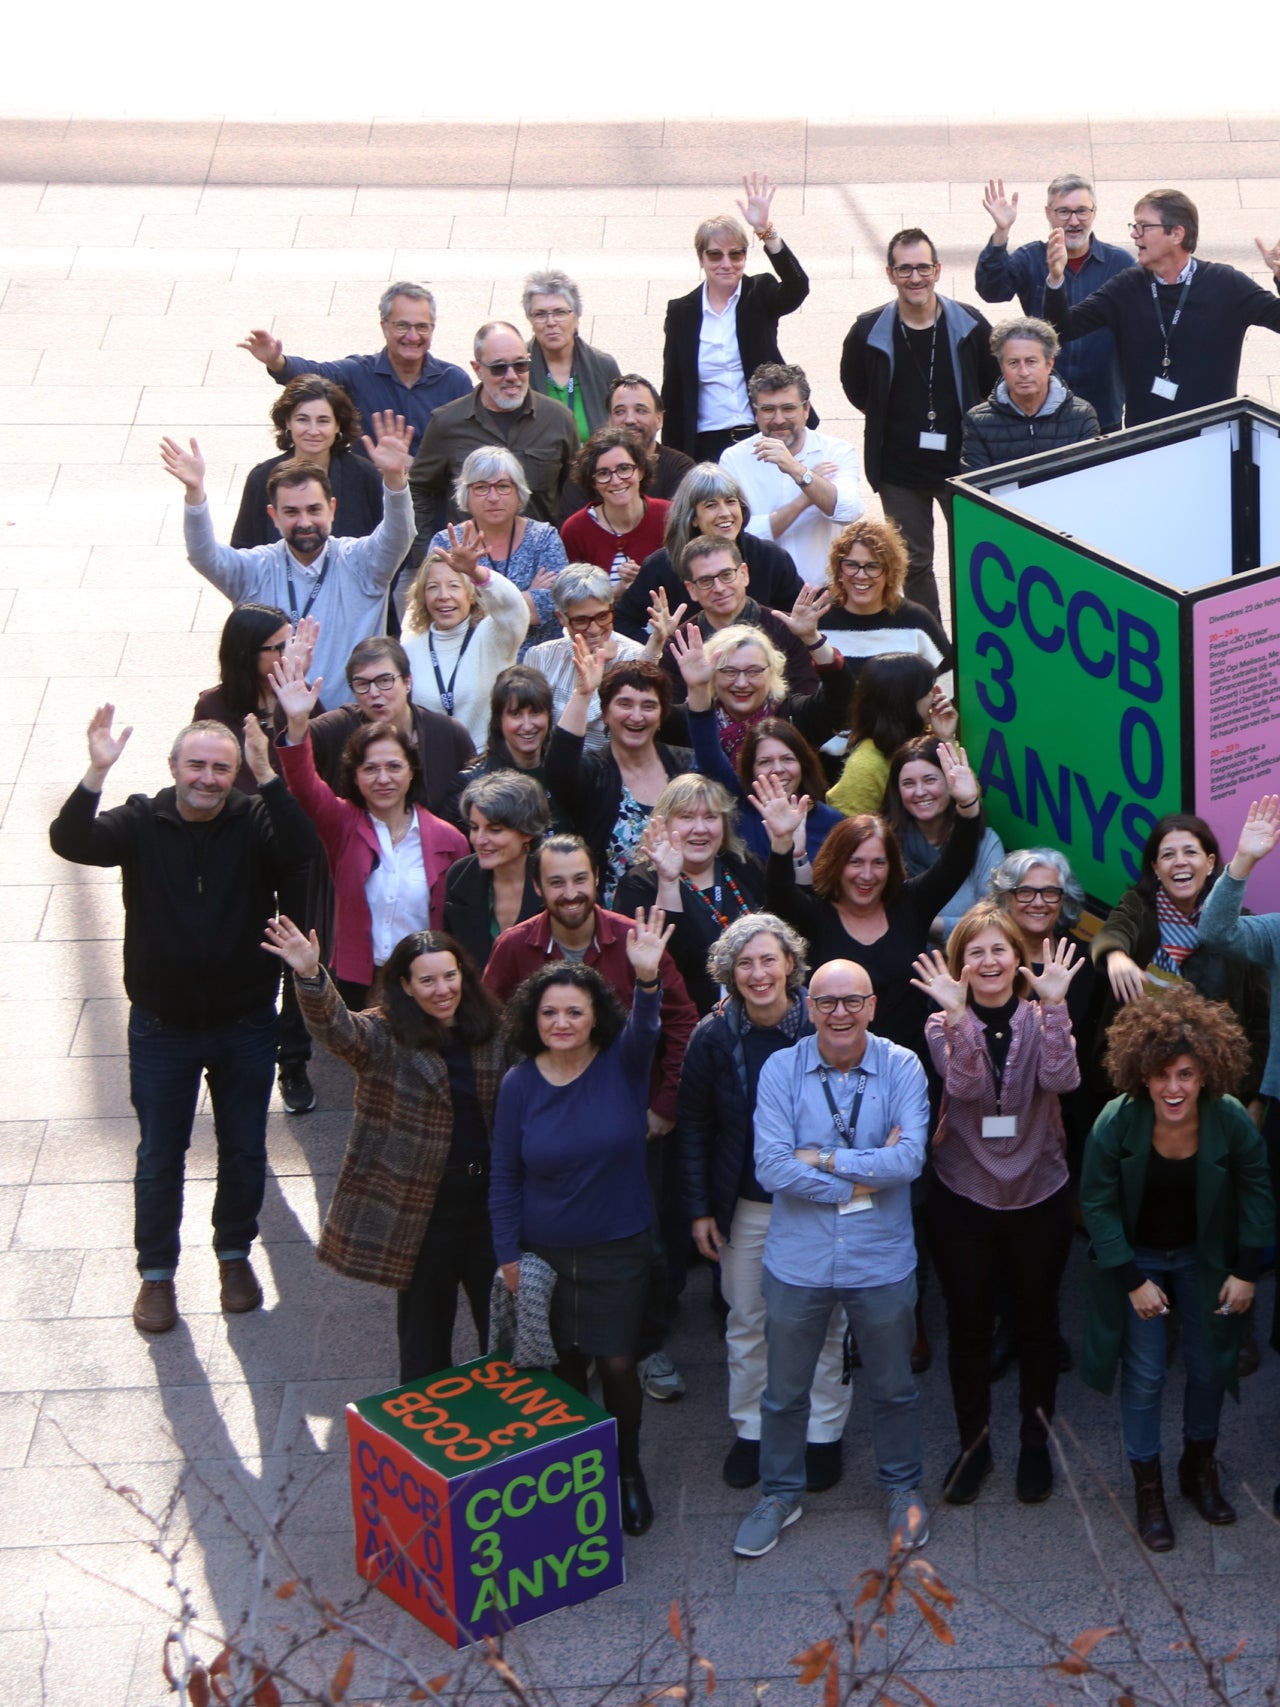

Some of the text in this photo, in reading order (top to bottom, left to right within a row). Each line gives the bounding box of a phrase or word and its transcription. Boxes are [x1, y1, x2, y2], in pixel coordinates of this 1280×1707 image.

[970, 541, 1163, 703] CCCB
[975, 631, 1164, 799] 3 0
[978, 728, 1159, 882] ANYS
[833, 1113, 845, 1133] CCCB
[857, 1074, 866, 1094] CCCB
[382, 1392, 491, 1461] CCCB
[470, 1361, 585, 1428] ANYS
[489, 1422, 537, 1445] 3
[357, 1440, 441, 1529] CCCB
[465, 1449, 606, 1531] CCCB
[361, 1483, 443, 1574] 3 0
[470, 1491, 607, 1577] 3 0
[363, 1529, 446, 1617] ANYS
[470, 1535, 610, 1623] ANYS
